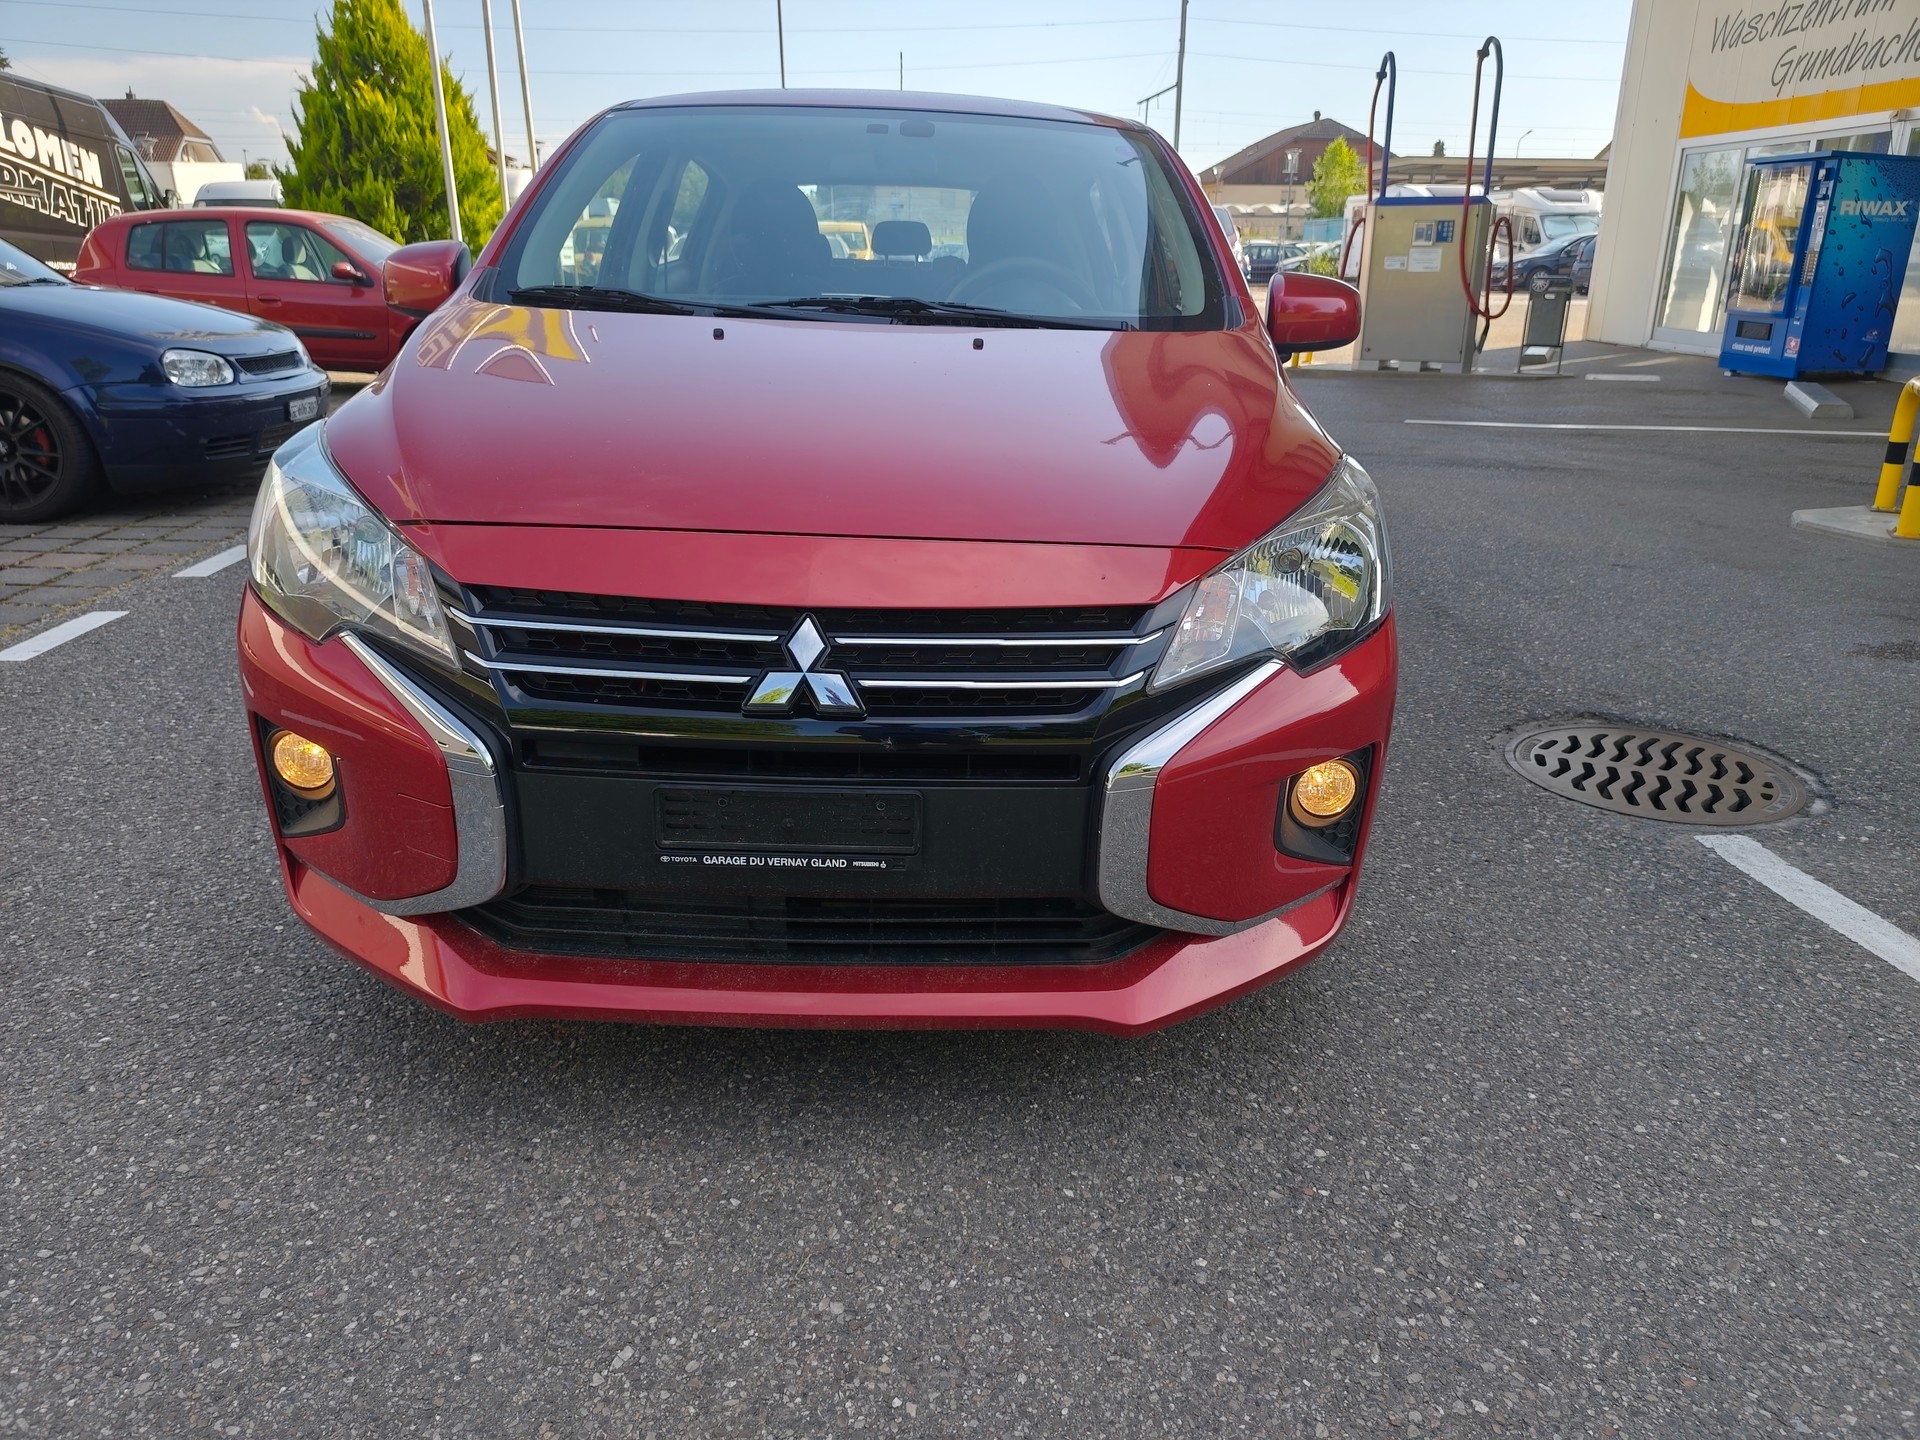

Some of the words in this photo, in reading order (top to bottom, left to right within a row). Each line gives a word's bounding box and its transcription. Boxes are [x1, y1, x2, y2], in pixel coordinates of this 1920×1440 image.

[1839, 200, 1909, 216] RIWAX
[1744, 344, 1753, 352] and
[1753, 346, 1771, 355] protect
[703, 856, 747, 865] GARAGE
[749, 856, 765, 866] DU
[767, 857, 808, 867] VERNAY
[811, 858, 847, 868] GLAND
